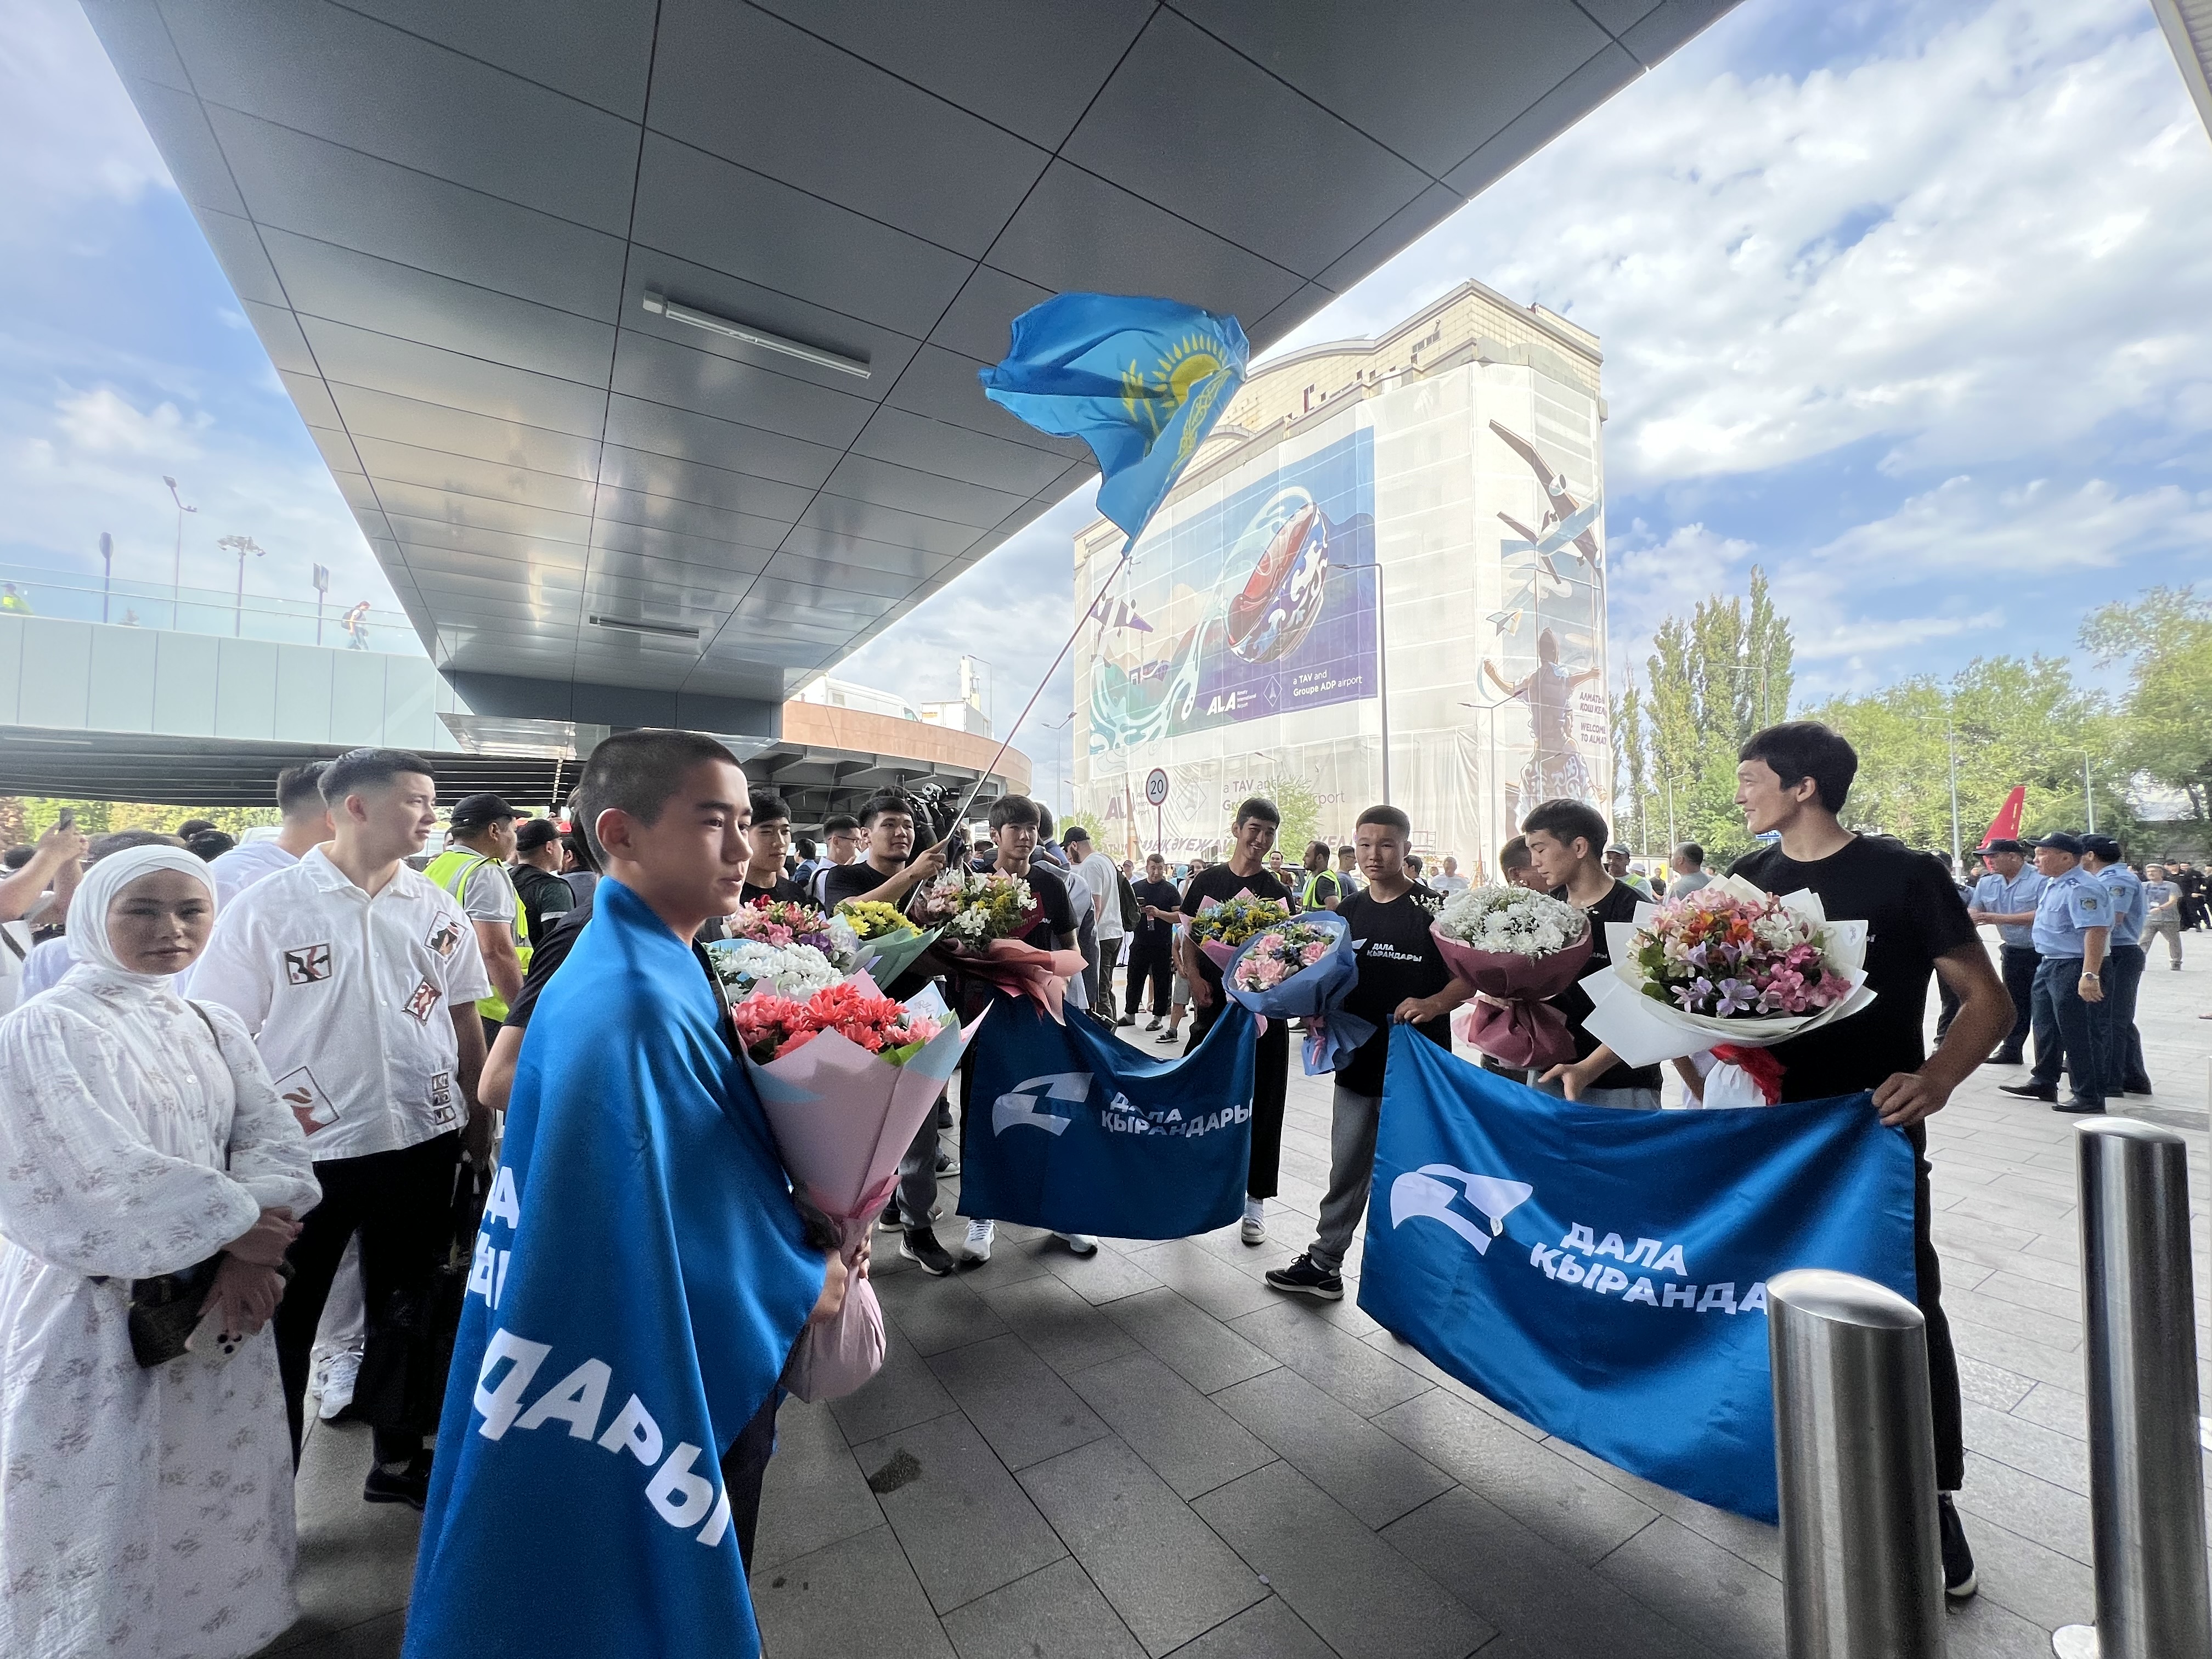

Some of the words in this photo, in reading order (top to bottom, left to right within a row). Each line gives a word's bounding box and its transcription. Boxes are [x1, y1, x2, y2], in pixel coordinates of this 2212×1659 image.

[1299, 673, 1313, 684] TAV
[1314, 669, 1327, 680] and
[1293, 685, 1319, 697] Groupe
[1320, 680, 1336, 691] ADP
[1338, 675, 1363, 687] airport
[1206, 692, 1236, 716] ALA
[1581, 733, 1589, 742] TO
[1150, 779, 1164, 795] 20
[1223, 785, 1229, 793] a
[1233, 779, 1254, 792] TAV
[1313, 791, 1345, 805] rport
[1104, 797, 1127, 820] AL
[1372, 943, 1394, 951] ДАЛА
[1560, 1222, 1688, 1277] ДАЛА
[1530, 1242, 1768, 1316] ҚЫРАНДА
